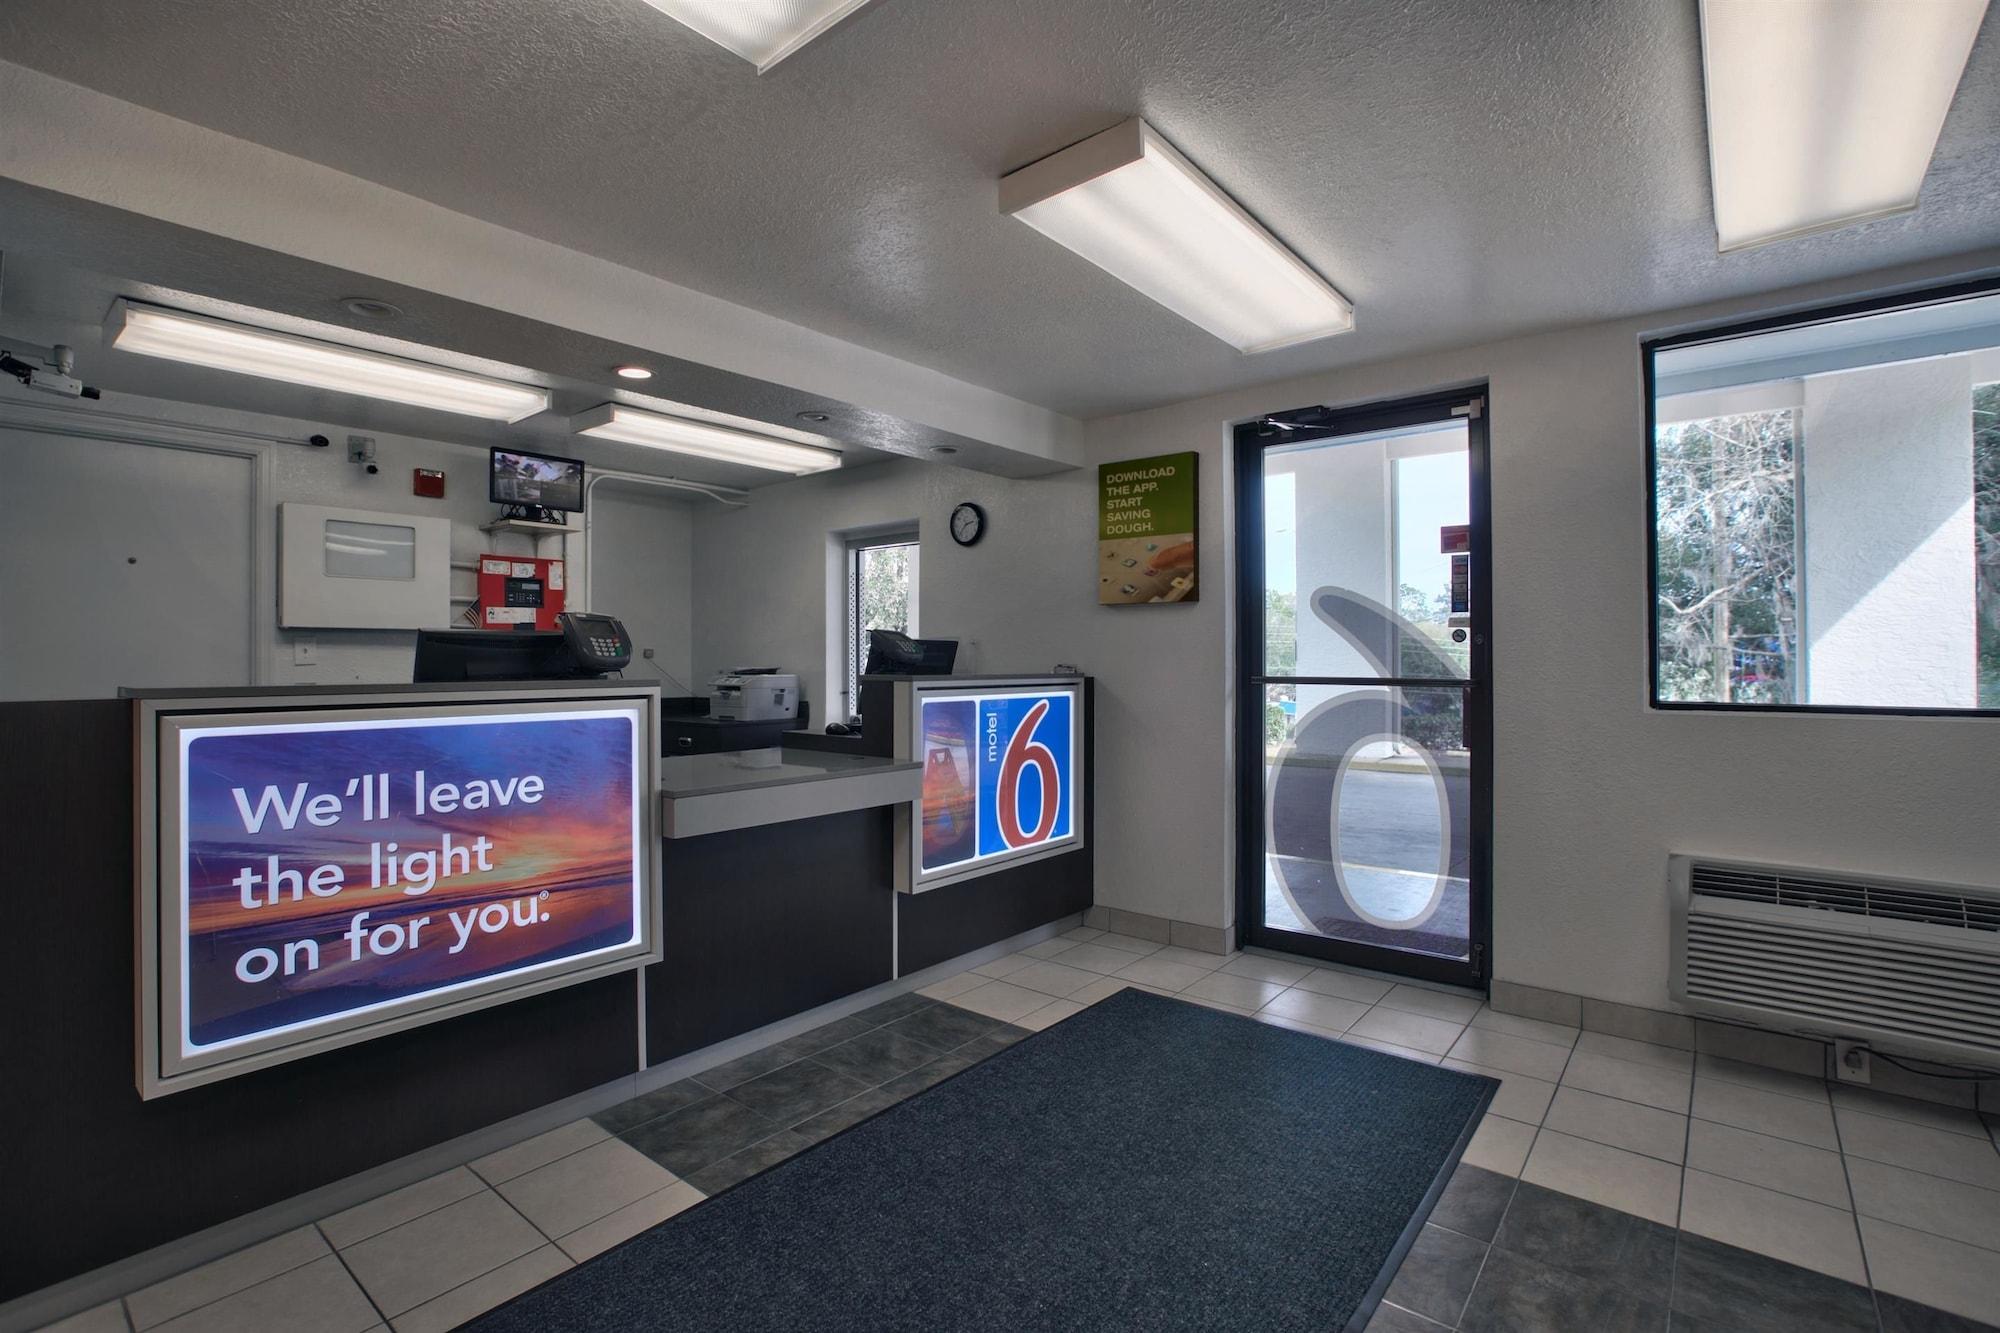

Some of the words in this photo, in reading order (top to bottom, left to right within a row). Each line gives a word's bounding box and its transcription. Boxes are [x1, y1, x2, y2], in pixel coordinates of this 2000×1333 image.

[1106, 467, 1175, 483] DOWNLOAD
[1106, 486, 1130, 497] THE
[1133, 482, 1159, 494] APP.
[1106, 497, 1143, 509] START
[1106, 509, 1151, 522] SAVING
[1106, 522, 1154, 535] DOUGH.
[987, 712, 997, 762] motel
[996, 699, 1060, 850] 6
[231, 773, 390, 834] We'll
[414, 770, 545, 816] leave
[231, 856, 345, 910] the
[370, 834, 493, 895] light
[234, 937, 320, 984] on
[343, 912, 430, 961] for
